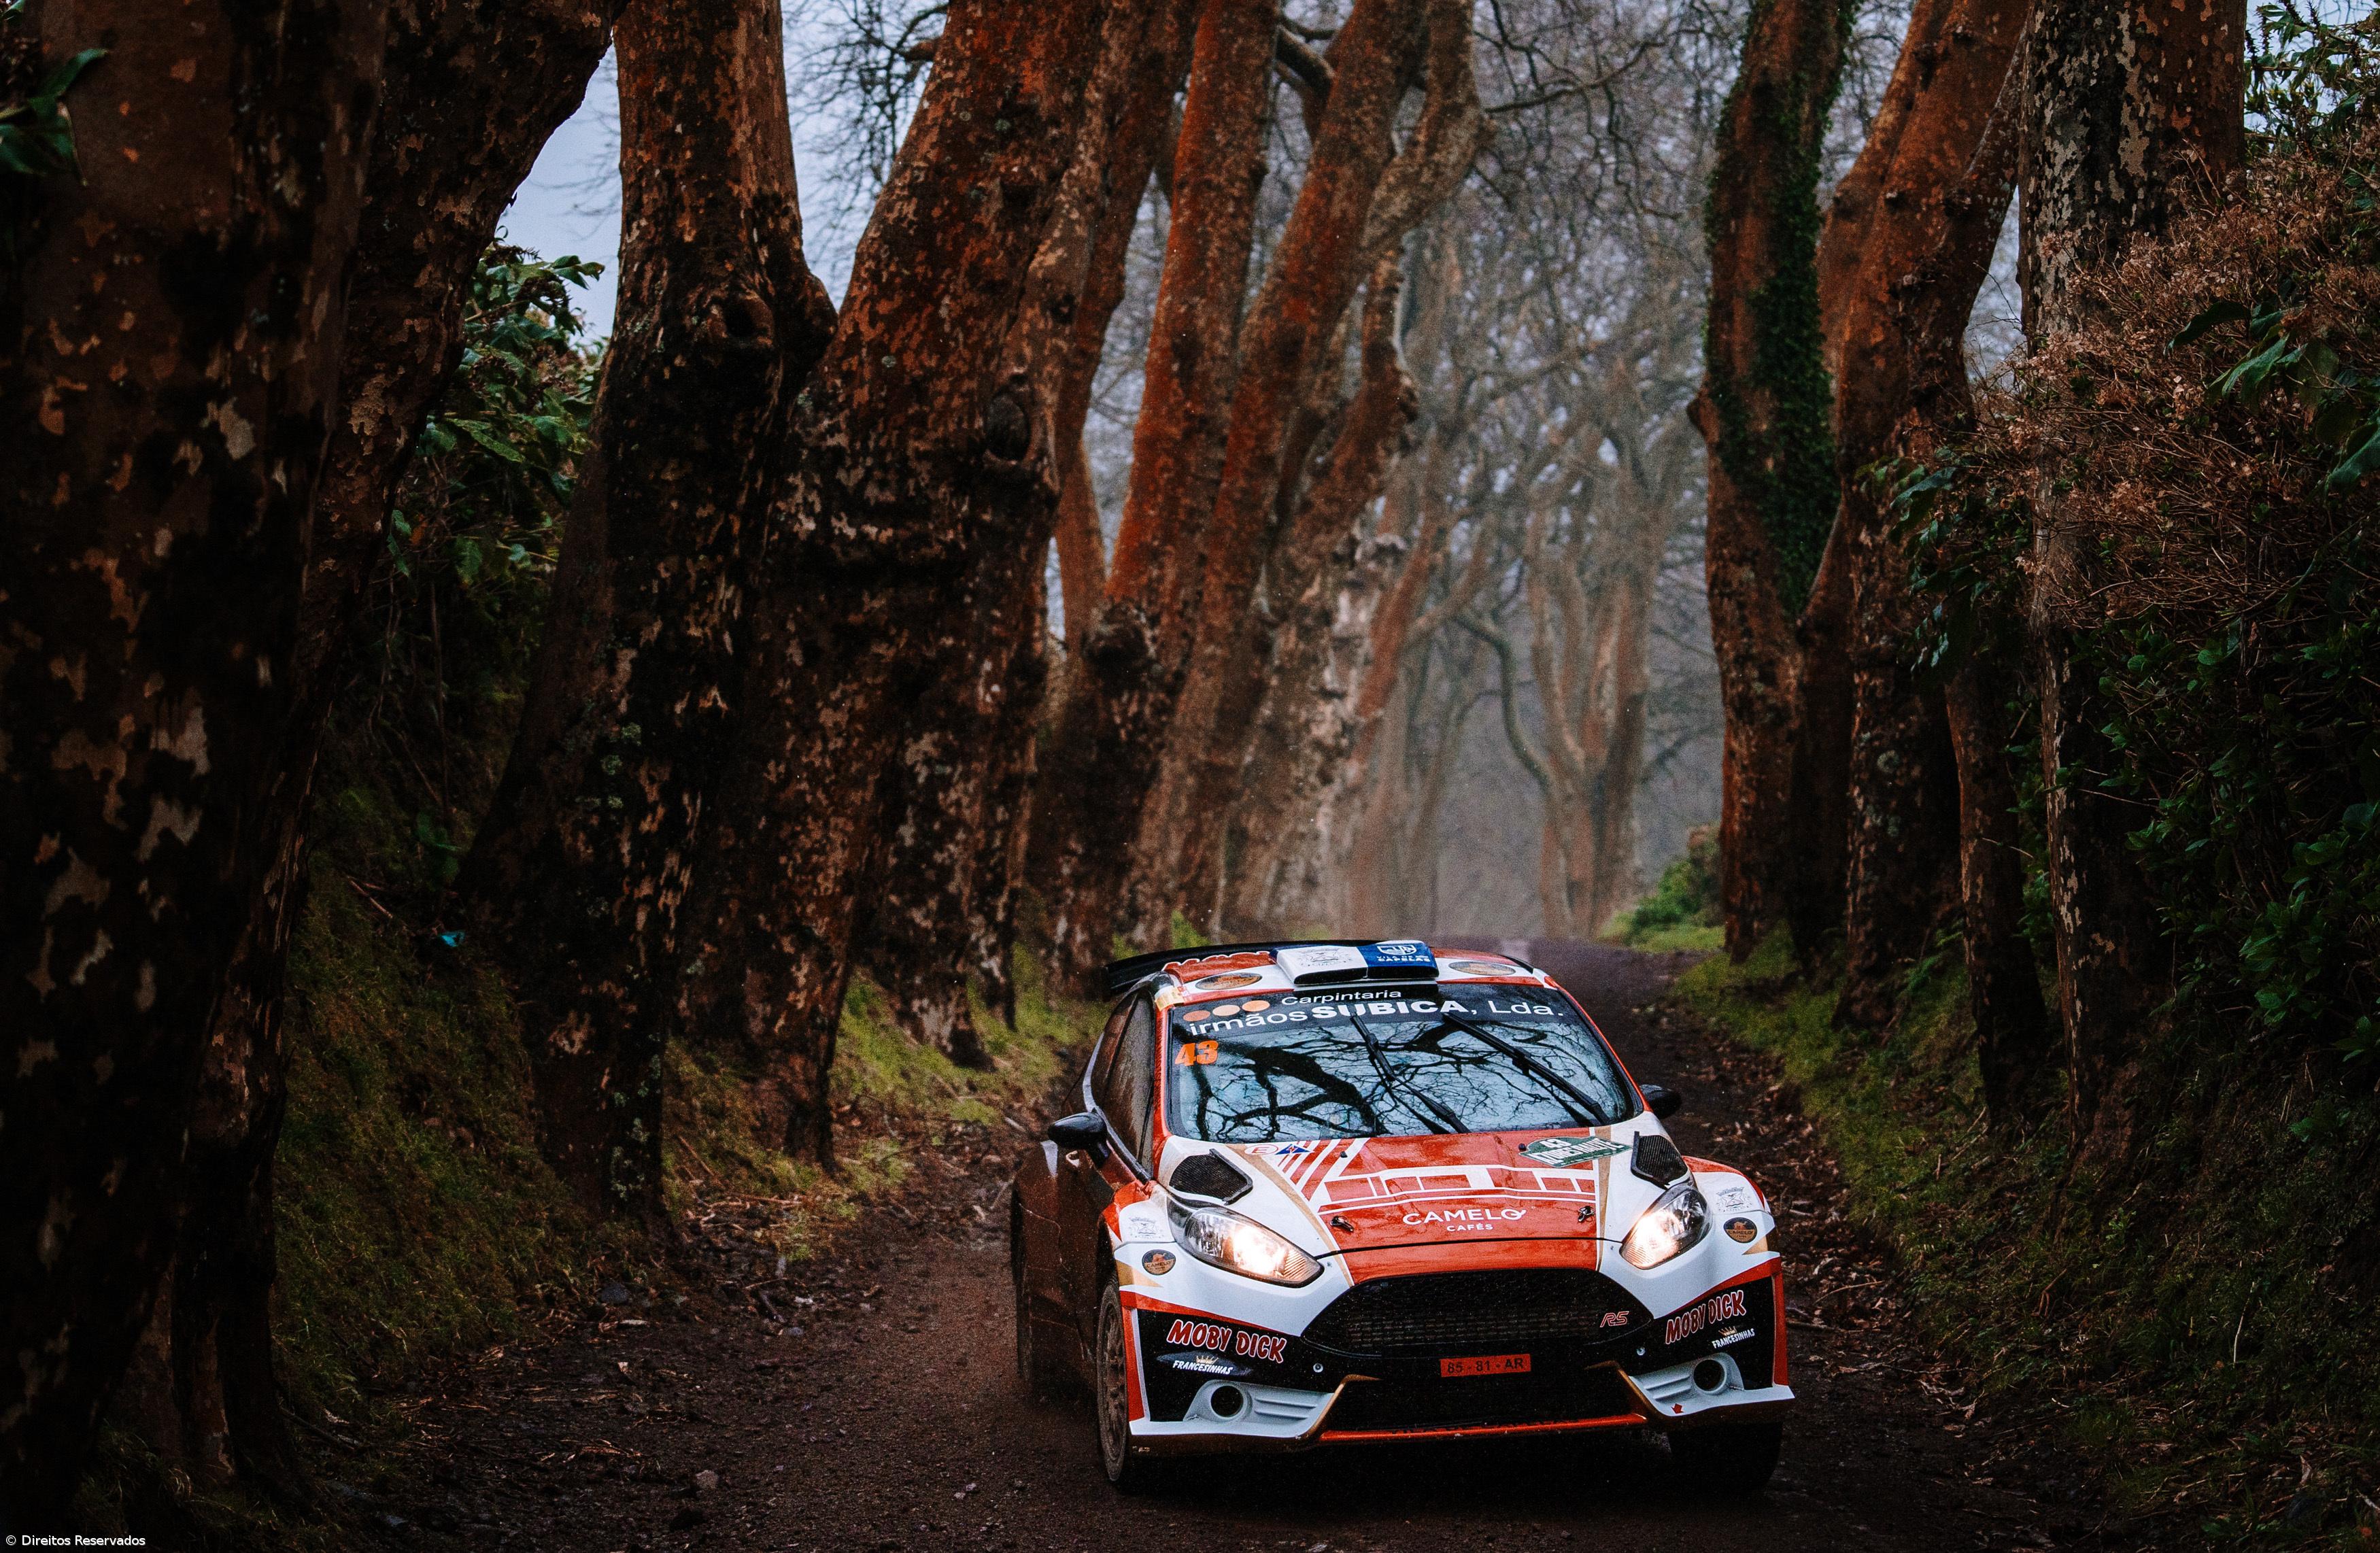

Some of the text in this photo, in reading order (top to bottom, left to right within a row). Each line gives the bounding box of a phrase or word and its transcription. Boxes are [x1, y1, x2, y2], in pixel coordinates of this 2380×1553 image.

[1282, 989, 1401, 1006] Carpintaria
[1190, 1000, 1564, 1036] irmãos SUBICA, Lda.
[1175, 1040, 1218, 1066] 43
[1540, 1138, 1571, 1148] 43
[1403, 1208, 1527, 1225] CAMELO
[1446, 1223, 1493, 1231] CAFÉS
[1600, 1311, 1629, 1327] RS
[1665, 1290, 1747, 1345] MOBY DICK
[1166, 1319, 1287, 1363] MOBY DICK
[1712, 1328, 1756, 1349] FRANCESINHAS
[1172, 1360, 1234, 1375] FRANCESINHAS
